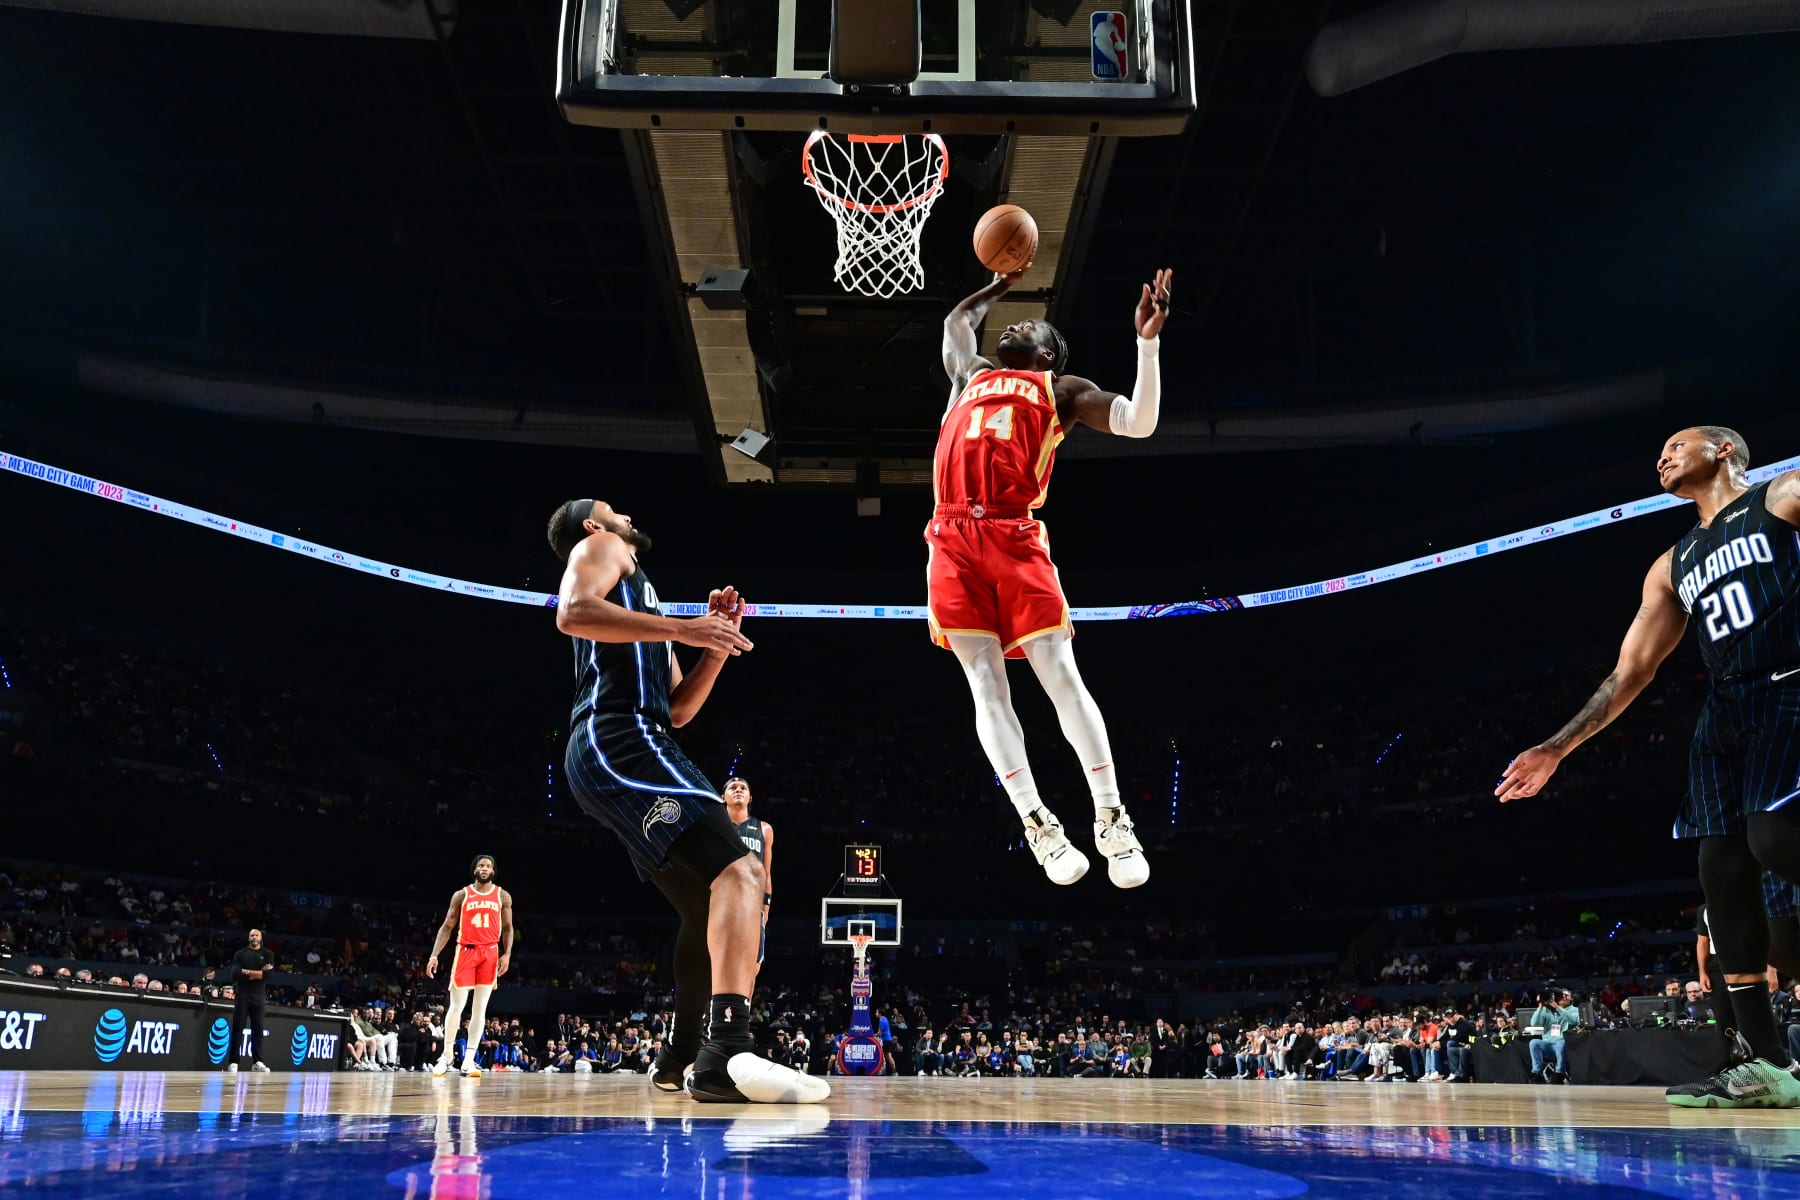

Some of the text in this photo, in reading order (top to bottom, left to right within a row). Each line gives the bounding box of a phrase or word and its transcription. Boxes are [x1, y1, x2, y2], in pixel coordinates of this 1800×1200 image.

[1097, 63, 1115, 75] NBA
[958, 377, 1039, 409] ATLANTA
[965, 406, 1013, 440] 14
[8, 456, 45, 478] MEXICO
[46, 468, 69, 485] CITY
[70, 475, 96, 493] GAME
[97, 483, 123, 501] 2023
[1678, 532, 1774, 615] ORLANDO
[1260, 590, 1287, 604] MEXICO
[1287, 587, 1304, 599] CITY
[1304, 583, 1325, 597] GAME
[1325, 578, 1346, 593] 2023
[676, 604, 702, 616] MEXICO
[1702, 580, 1755, 643] 20
[855, 849, 877, 859] 4:21
[858, 858, 874, 876] 13
[466, 900, 499, 912] ATLANTA
[471, 912, 490, 928] 41
[0, 1010, 46, 1050] &T
[127, 1020, 178, 1054] AT&T
[307, 1033, 338, 1059] AT&T
